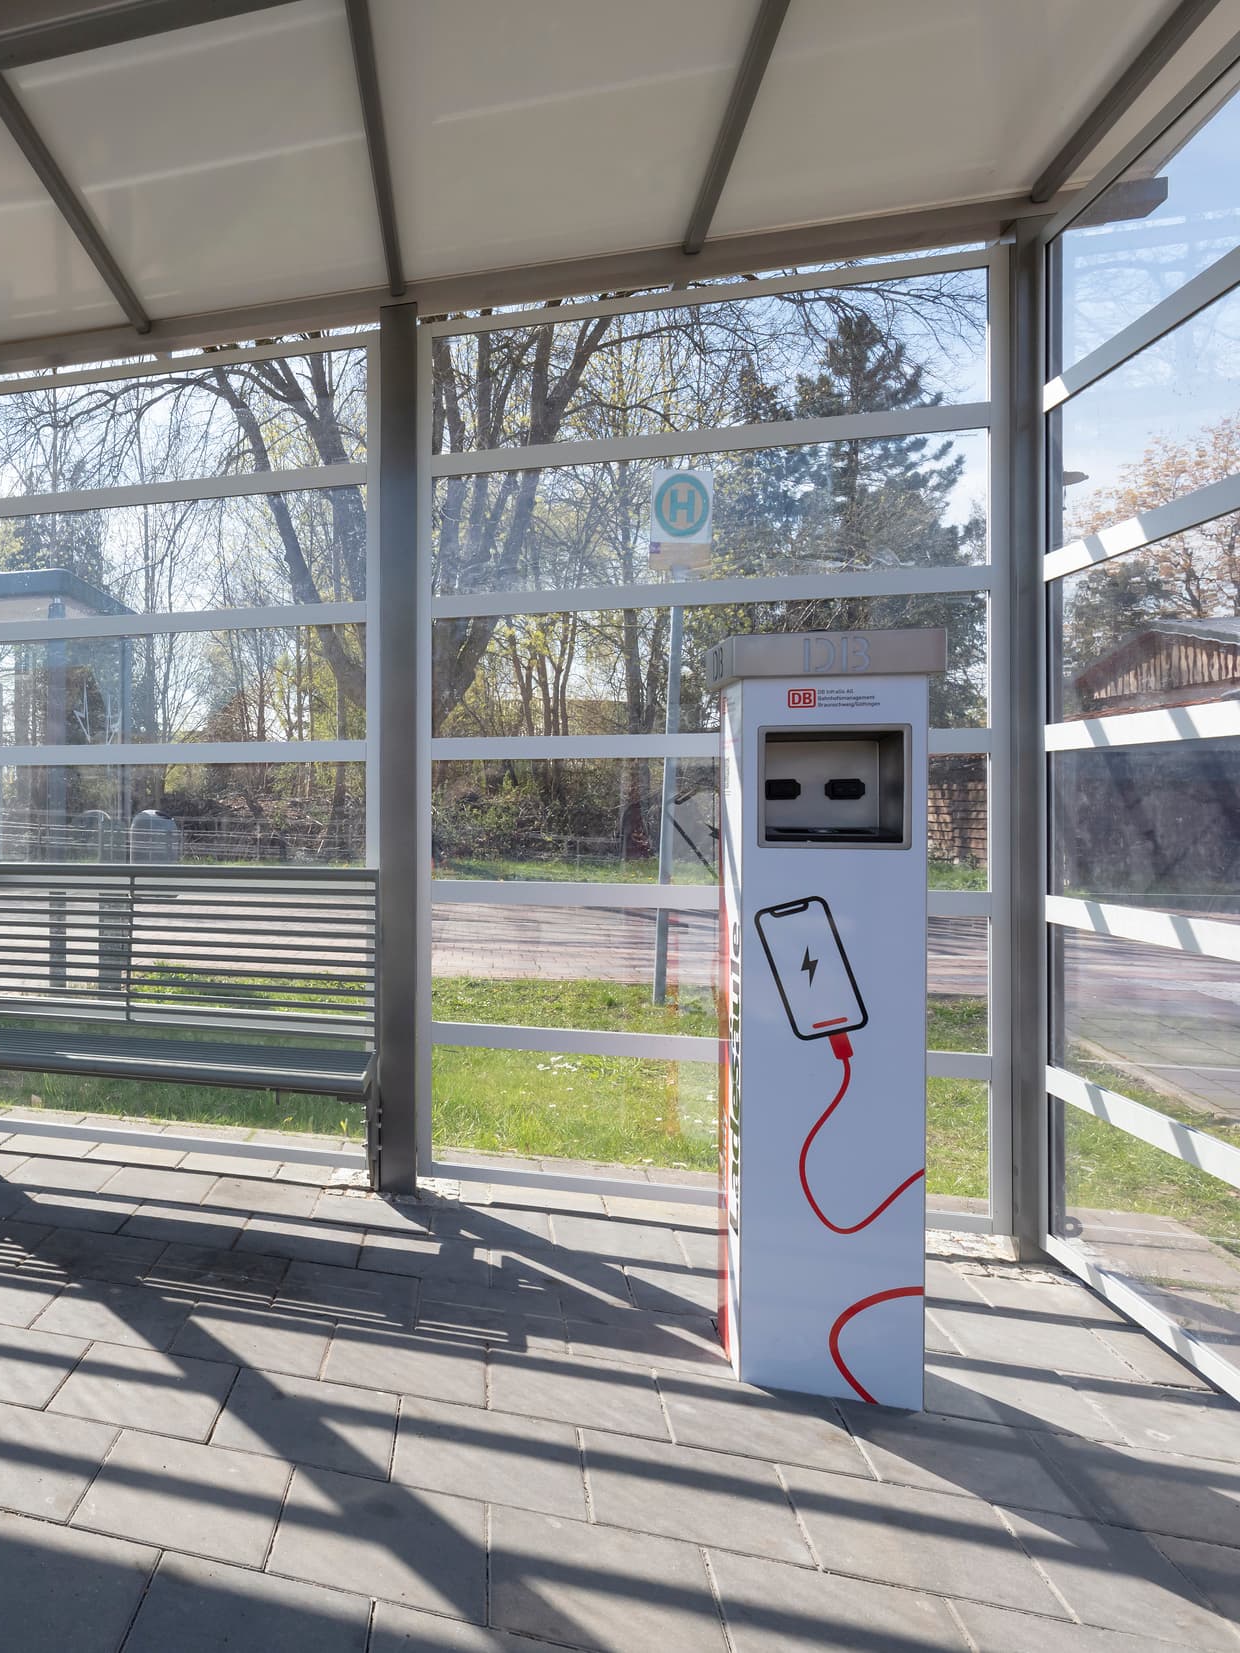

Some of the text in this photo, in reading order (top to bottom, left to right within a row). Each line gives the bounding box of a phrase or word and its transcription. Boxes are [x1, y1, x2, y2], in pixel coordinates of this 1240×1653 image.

[668, 488, 696, 523] H
[712, 646, 724, 682] DB
[803, 636, 872, 672] DB
[790, 691, 814, 706] DB
[729, 920, 740, 1238] Ladesäule
